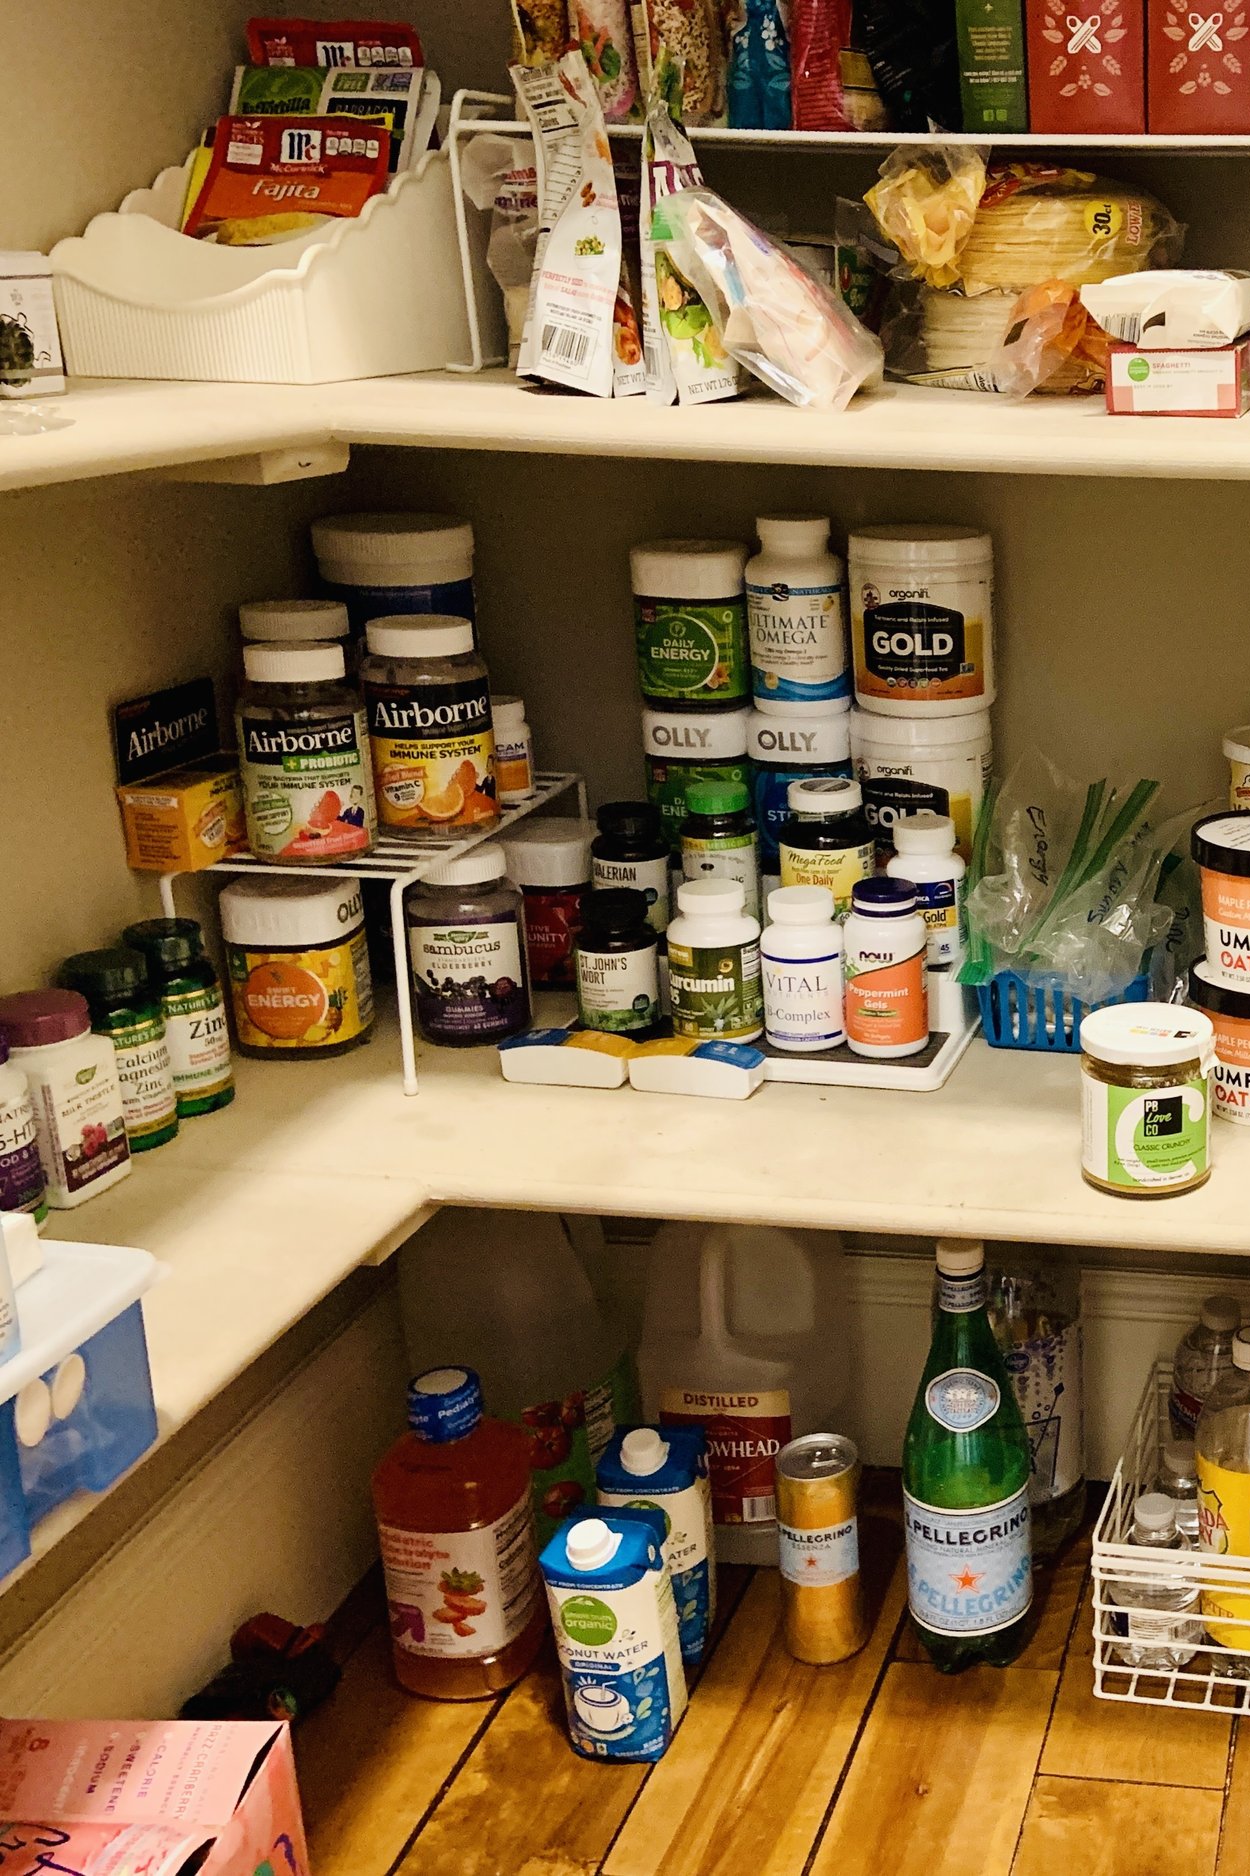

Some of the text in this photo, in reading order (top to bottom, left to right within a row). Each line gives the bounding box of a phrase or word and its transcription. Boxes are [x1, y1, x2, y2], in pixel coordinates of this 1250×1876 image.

[252, 179, 320, 201] Fajita
[1152, 362, 1191, 370] SPAGHETTI
[750, 613, 829, 629] ULTIMATE
[662, 638, 695, 648] DAILY
[756, 629, 817, 645] OMEGA
[872, 631, 954, 656] GOLD
[651, 647, 711, 661] ENERGY
[374, 695, 487, 728] Airborne
[128, 707, 208, 761] Airborne
[250, 727, 353, 753] Airborne
[652, 725, 709, 747] OLLY
[758, 729, 817, 751] OLLY
[390, 745, 482, 760] IMMUNE SYSTEM
[300, 754, 358, 769] PROBIOTIC
[280, 778, 351, 789] IMMUNE SYSTEM
[384, 782, 411, 793] Vitamin
[1026, 805, 1050, 887] Energy
[788, 851, 846, 869] MegaFood
[796, 872, 834, 887] One Daily
[1217, 895, 1246, 909] MAPLE
[923, 909, 947, 924] Gold
[423, 940, 501, 956] sambucus
[431, 960, 492, 969] ELDERBERRY
[579, 954, 628, 971] ST. JOHN'S
[581, 971, 605, 985] WORT
[848, 983, 909, 998] Peppermint
[247, 993, 320, 1008] ENERGY
[864, 1000, 888, 1010] Gels
[767, 1006, 831, 1024] B-Complex
[1145, 1100, 1158, 1112] PB
[1146, 1112, 1172, 1123] Love
[1145, 1124, 1159, 1135] CO
[1133, 1144, 1161, 1152] CLASSIC
[683, 1393, 759, 1408] DISTILLED
[792, 1543, 831, 1551] ESSENZA
[565, 1618, 613, 1631] organic
[603, 1641, 649, 1660] WATER
[574, 1662, 613, 1670] ORIGINAL
